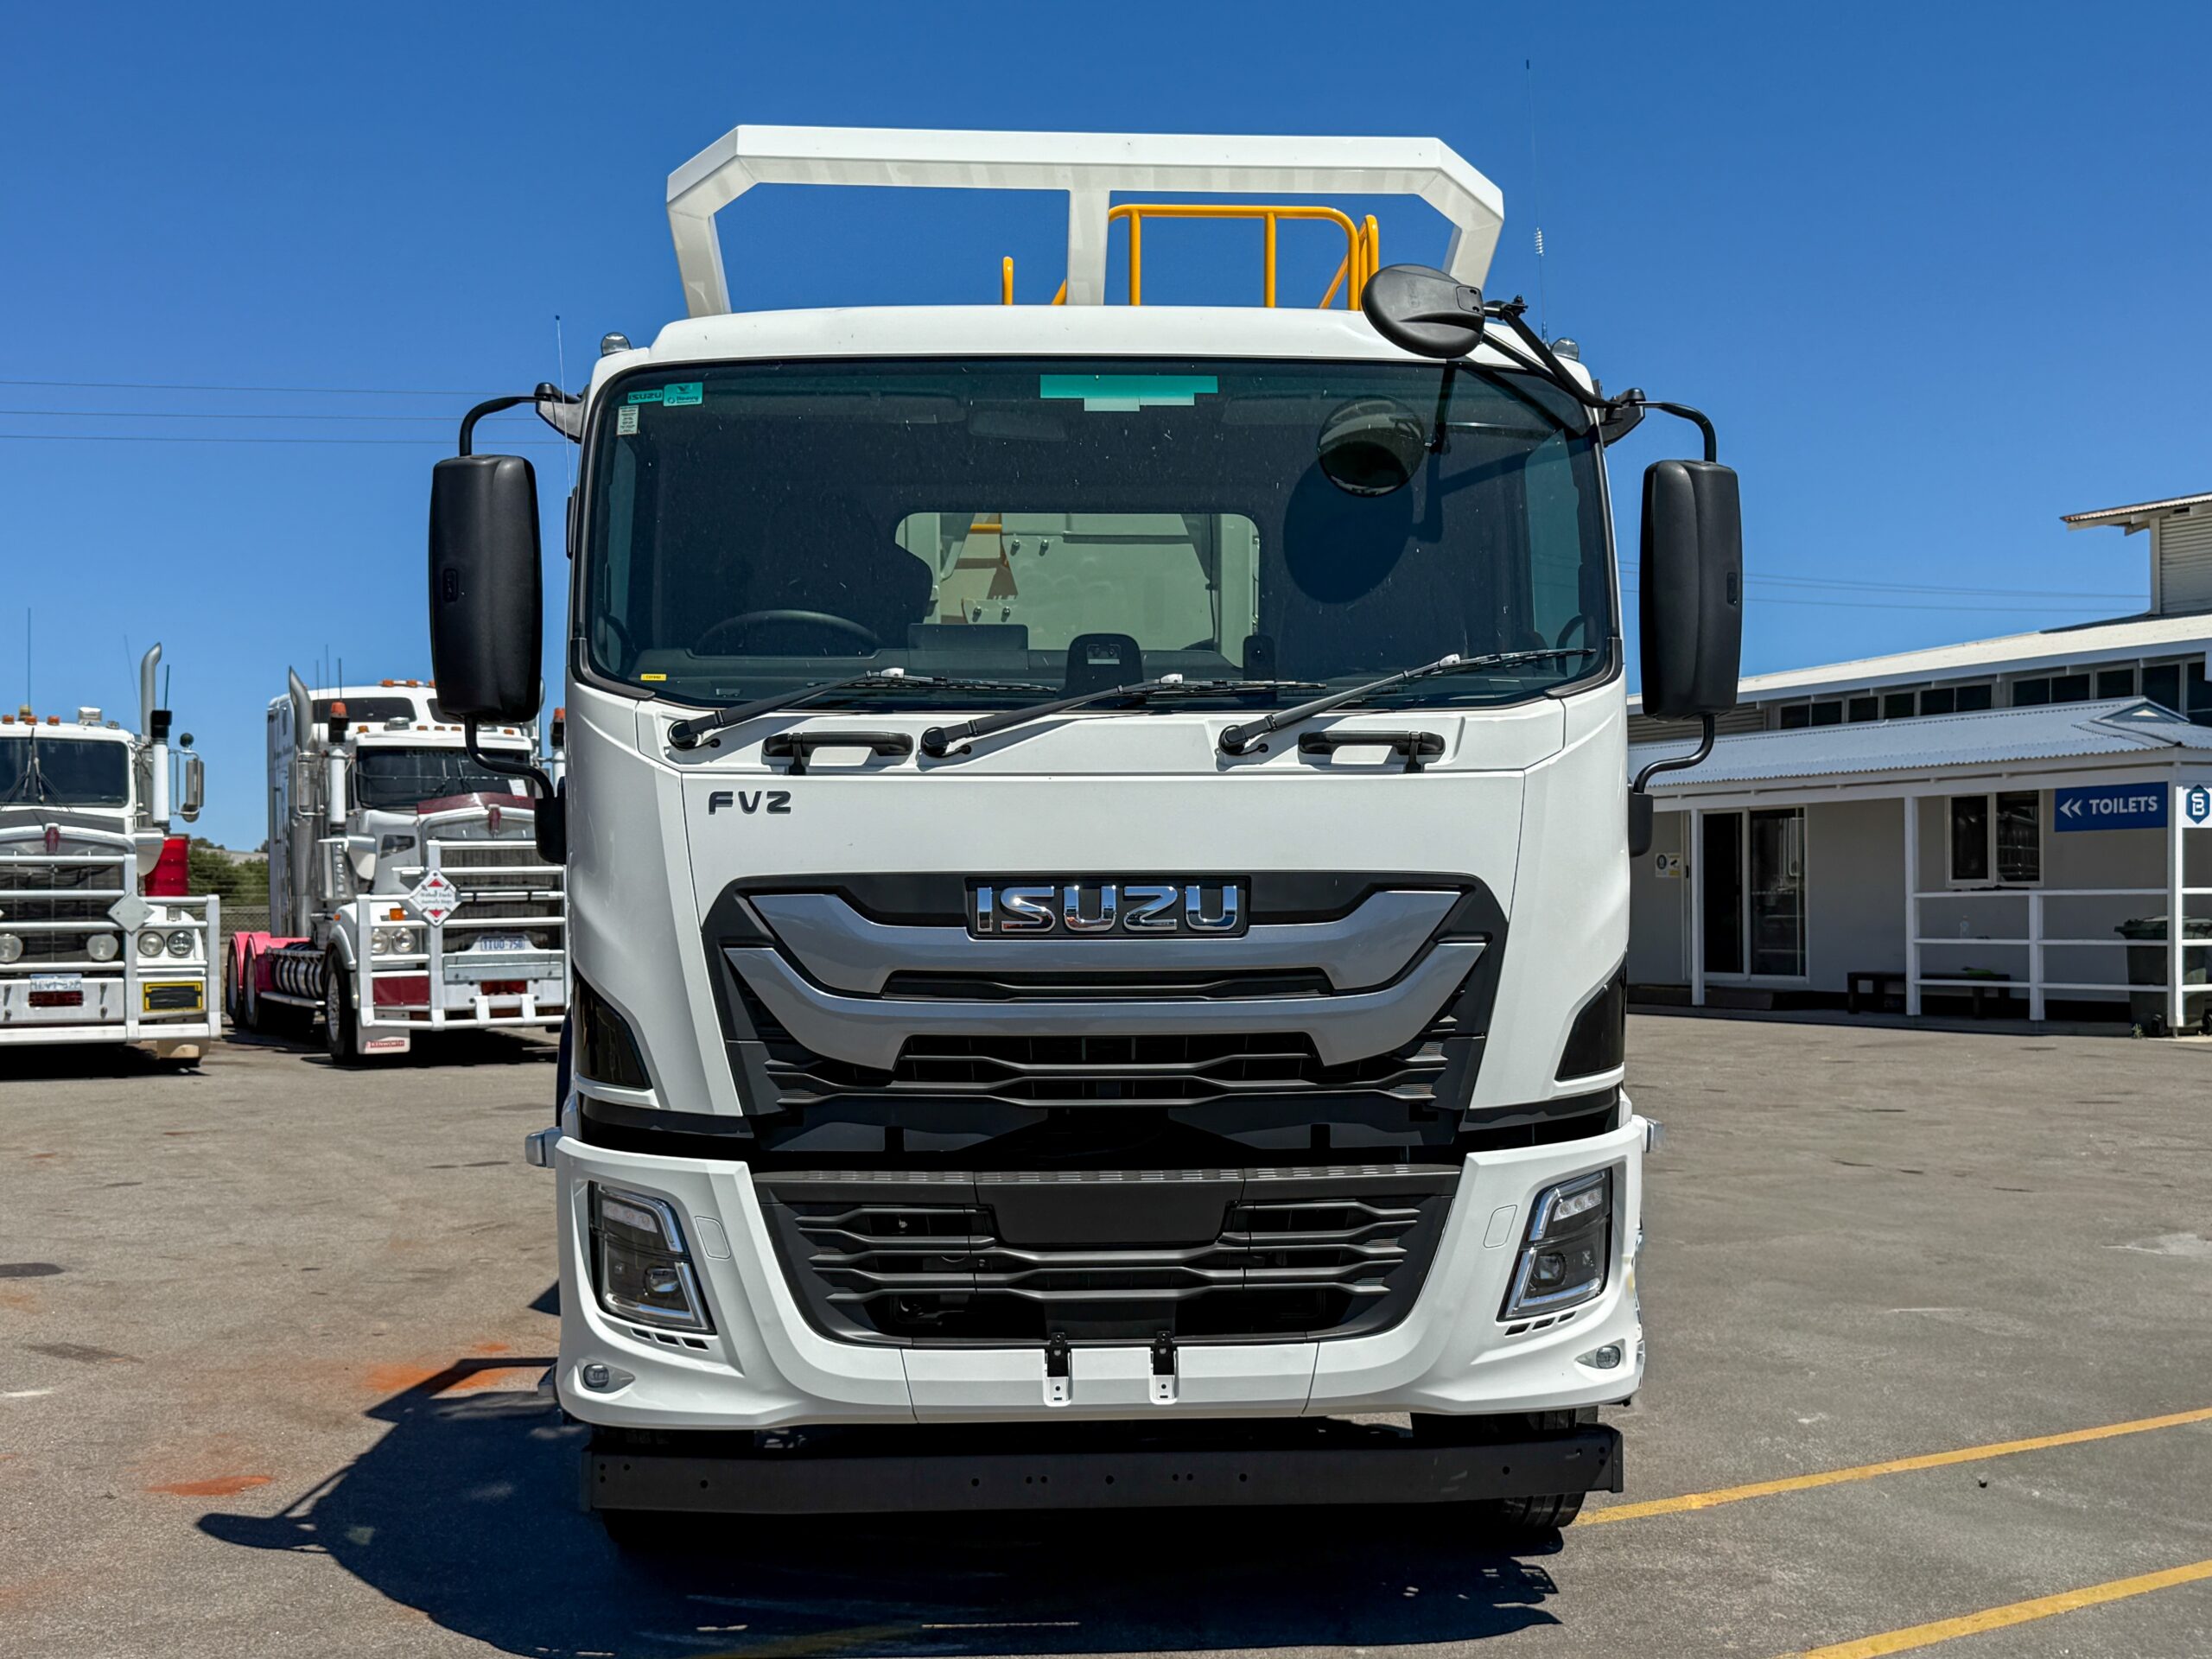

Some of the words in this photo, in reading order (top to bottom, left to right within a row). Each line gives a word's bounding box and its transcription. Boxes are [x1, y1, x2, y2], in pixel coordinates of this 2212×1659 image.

[709, 791, 791, 815] FVZ
[2088, 796, 2158, 815] TOILETS
[976, 886, 1237, 932] ISUZU
